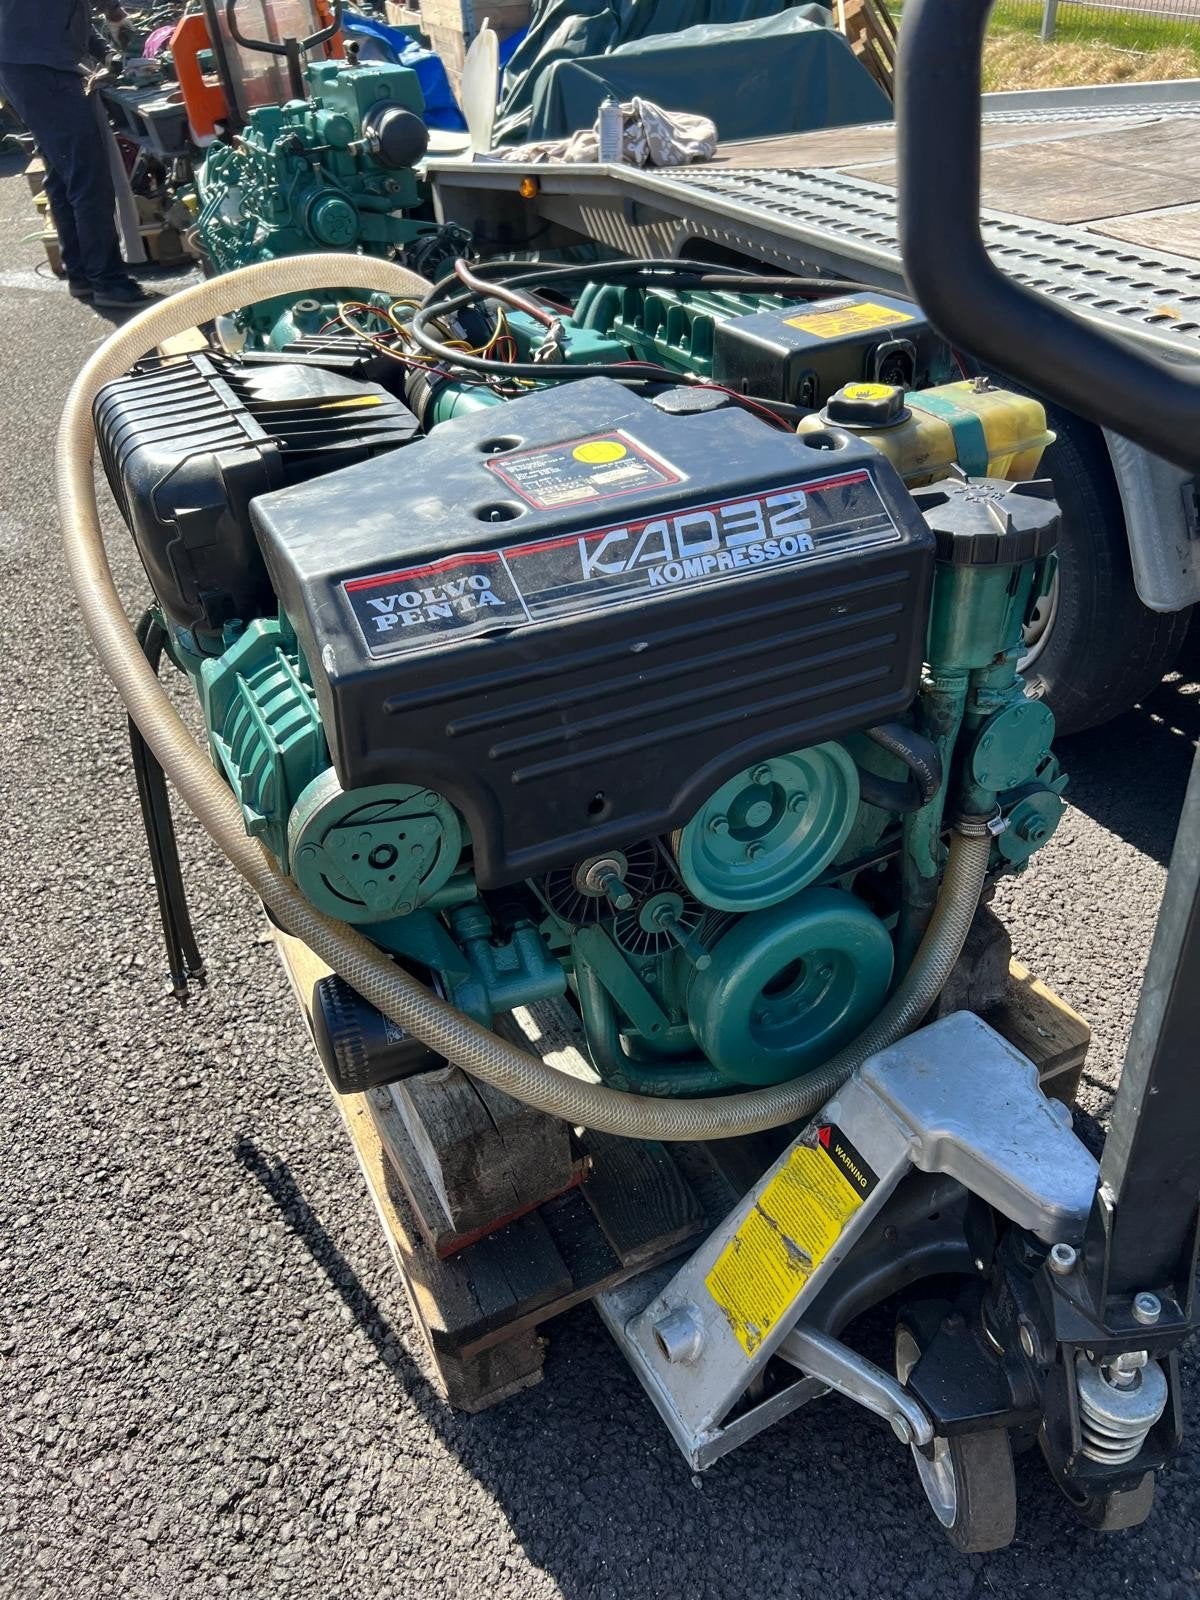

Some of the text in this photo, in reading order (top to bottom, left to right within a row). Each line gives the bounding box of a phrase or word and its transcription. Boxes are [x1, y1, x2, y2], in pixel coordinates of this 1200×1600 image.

[578, 490, 811, 580] KAD32
[647, 534, 815, 587] KOMPRESSOR
[367, 574, 491, 614] VOLVO
[371, 590, 505, 632] PENTA
[835, 1144, 868, 1188] WARNING
